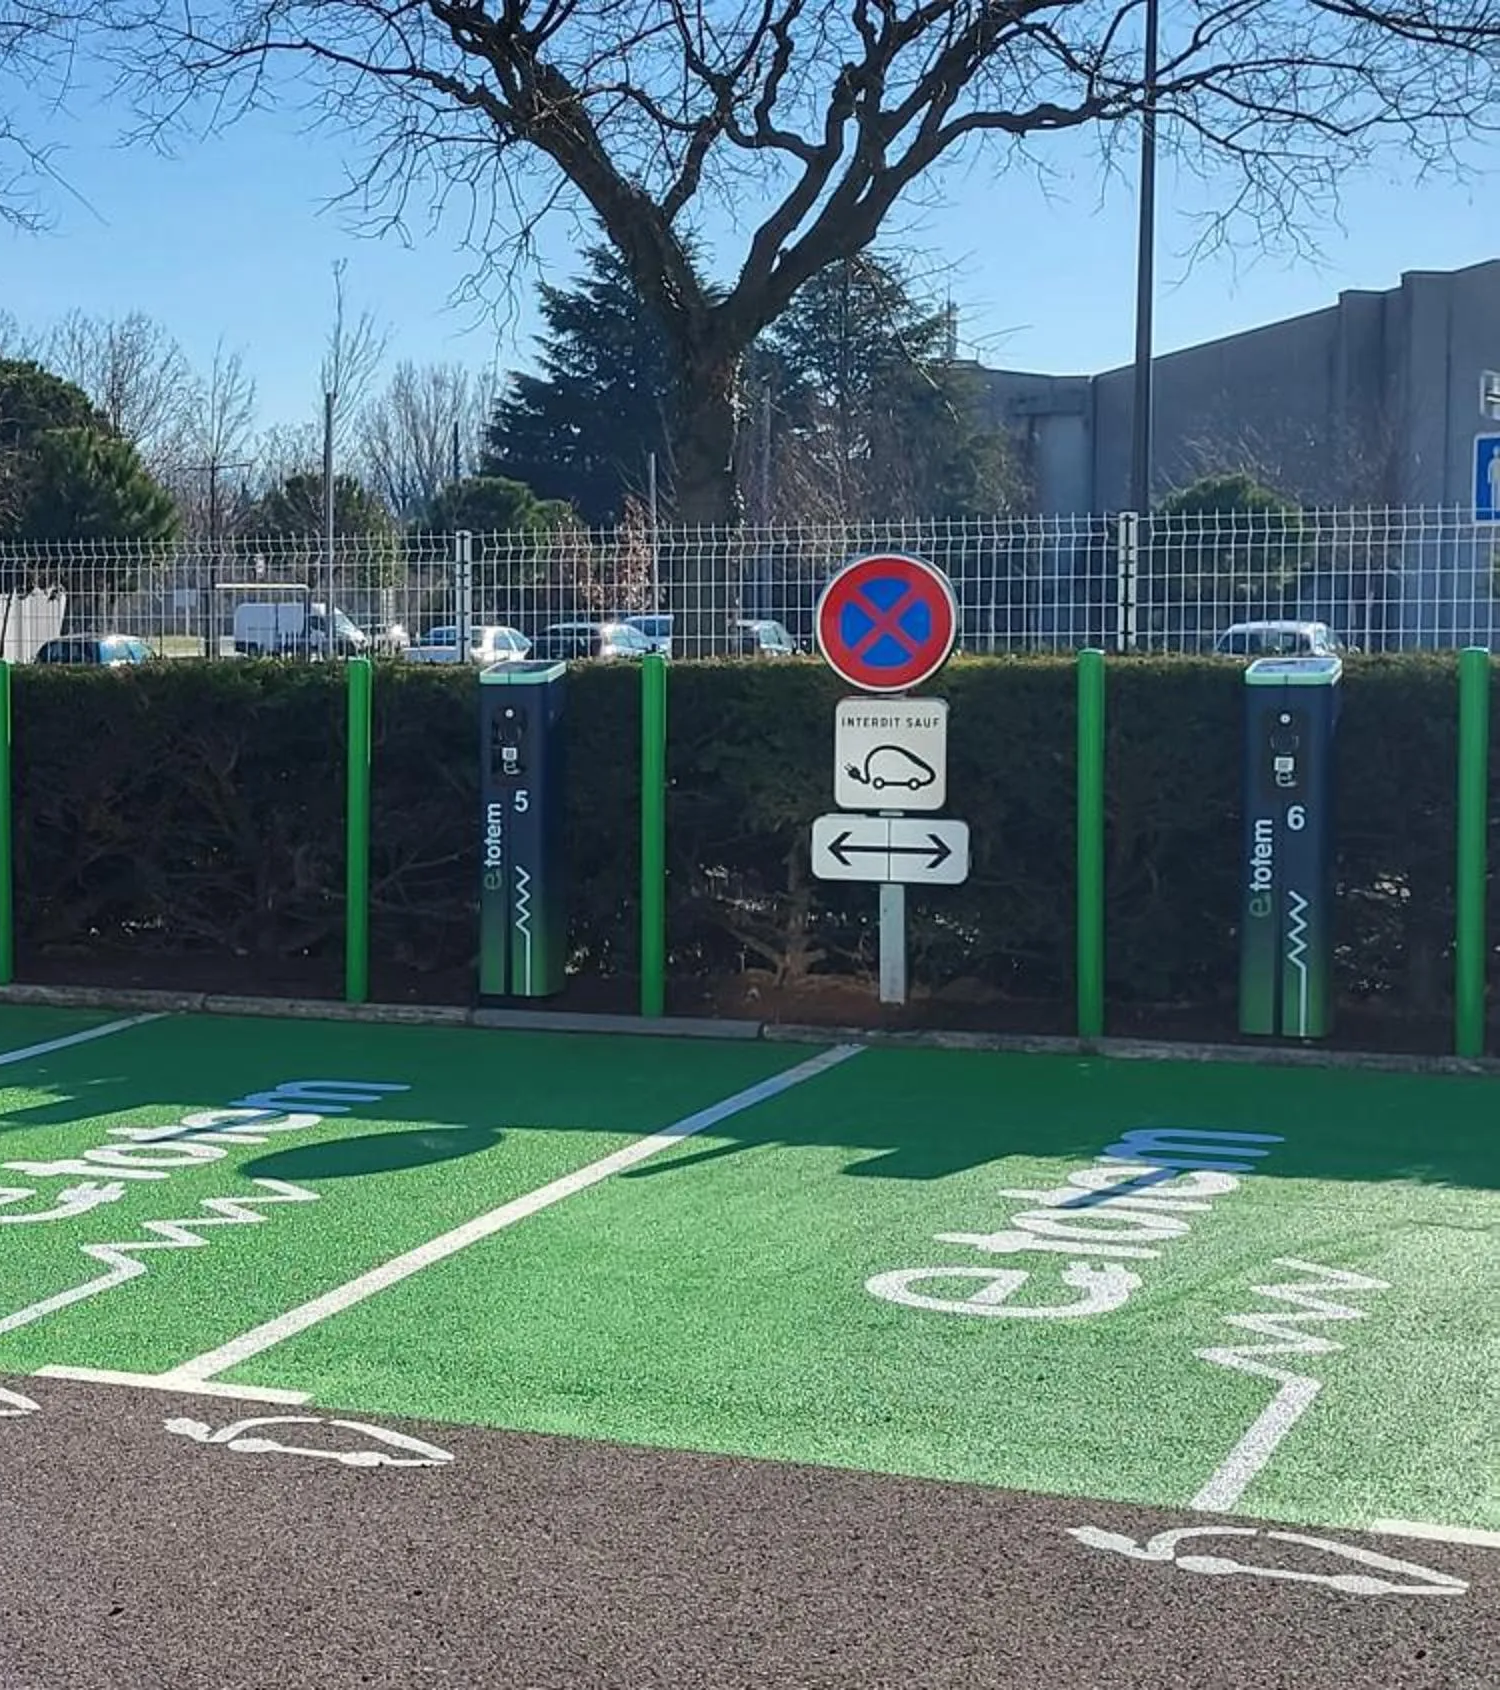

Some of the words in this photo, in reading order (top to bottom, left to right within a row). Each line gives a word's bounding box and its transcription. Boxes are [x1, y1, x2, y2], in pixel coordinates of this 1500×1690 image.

[841, 716, 901, 729] INTERDIT
[906, 716, 940, 729] SAUF
[514, 789, 529, 813] 5
[1287, 805, 1306, 831] 6
